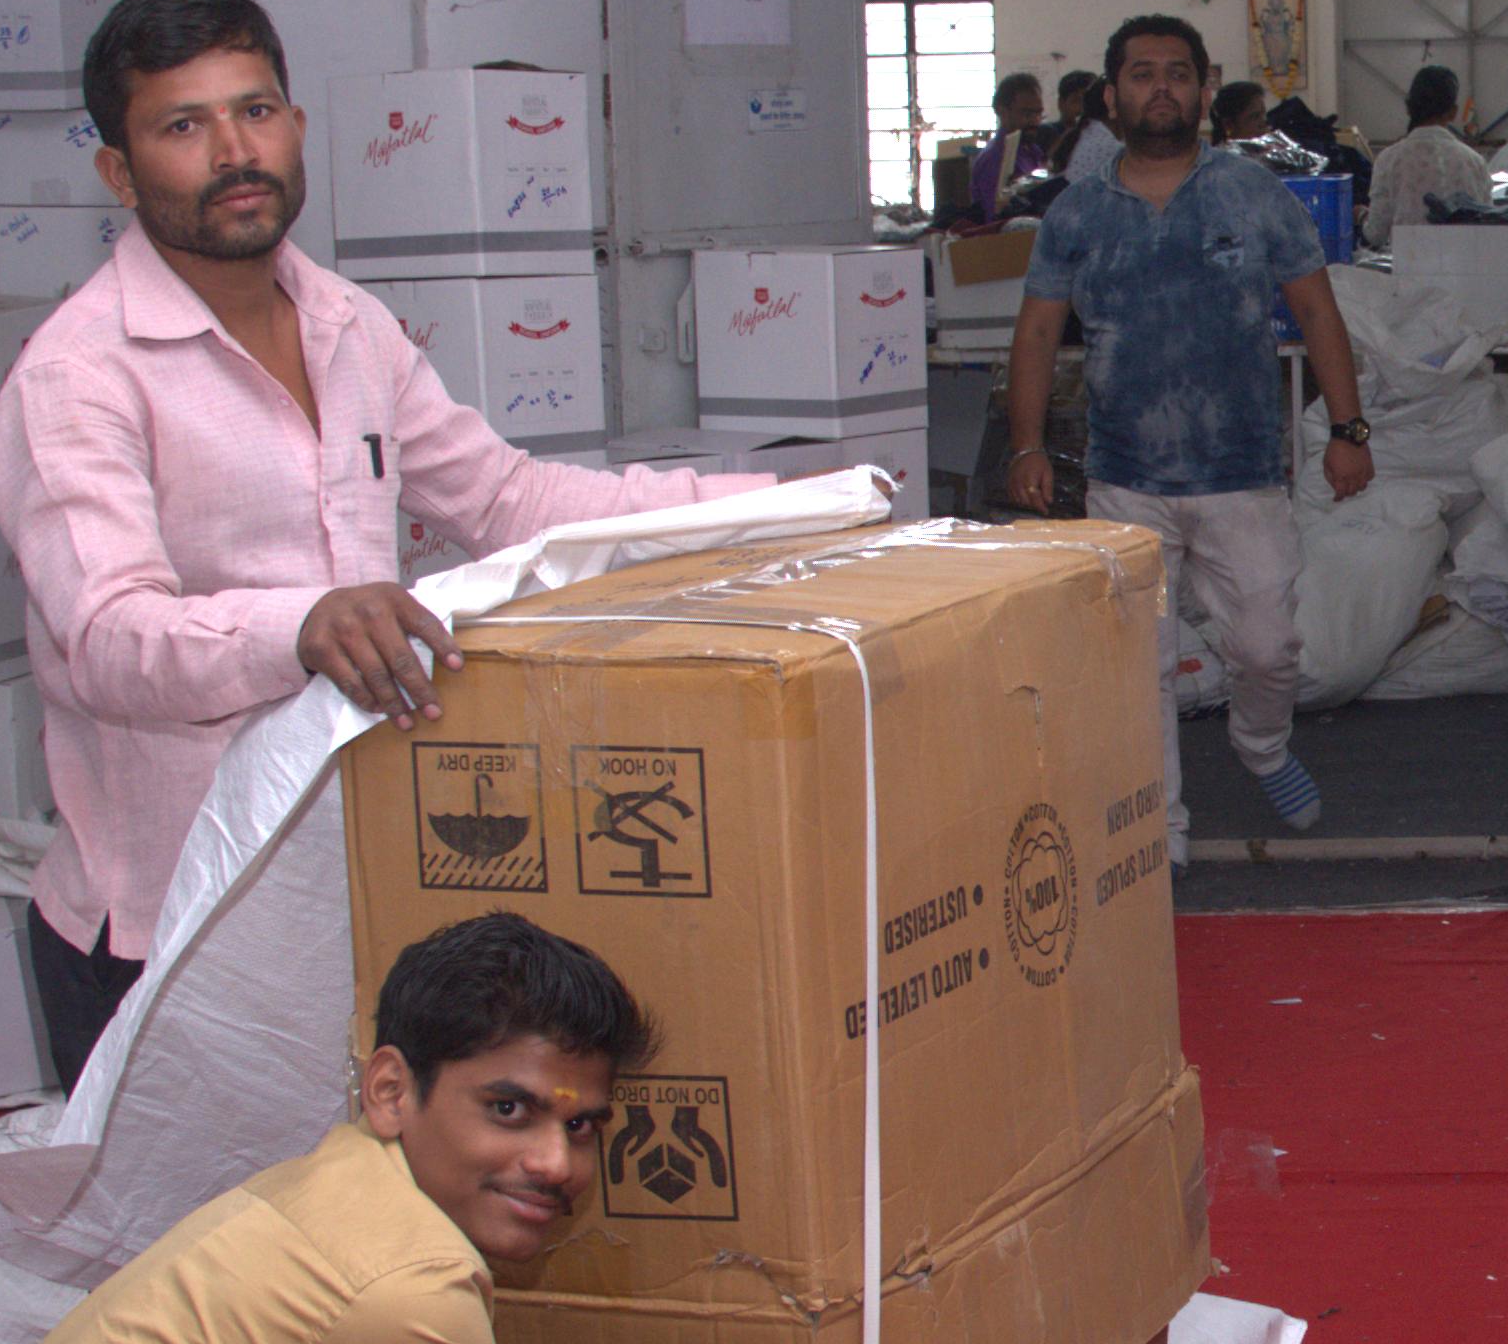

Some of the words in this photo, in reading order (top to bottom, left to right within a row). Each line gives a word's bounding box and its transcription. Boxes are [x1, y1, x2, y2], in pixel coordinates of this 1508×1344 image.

[363, 113, 436, 168] Mafatlal
[727, 291, 798, 337] Mafatlal
[437, 753, 470, 773] DRY
[474, 754, 517, 774] KEEP
[599, 757, 649, 778] HOOK
[652, 758, 678, 778] NO
[1024, 875, 1060, 915] 100%
[883, 884, 968, 955] USTERISED
[931, 947, 973, 998] AUTO
[655, 1085, 691, 1105] NOT
[694, 1085, 720, 1105] DO
